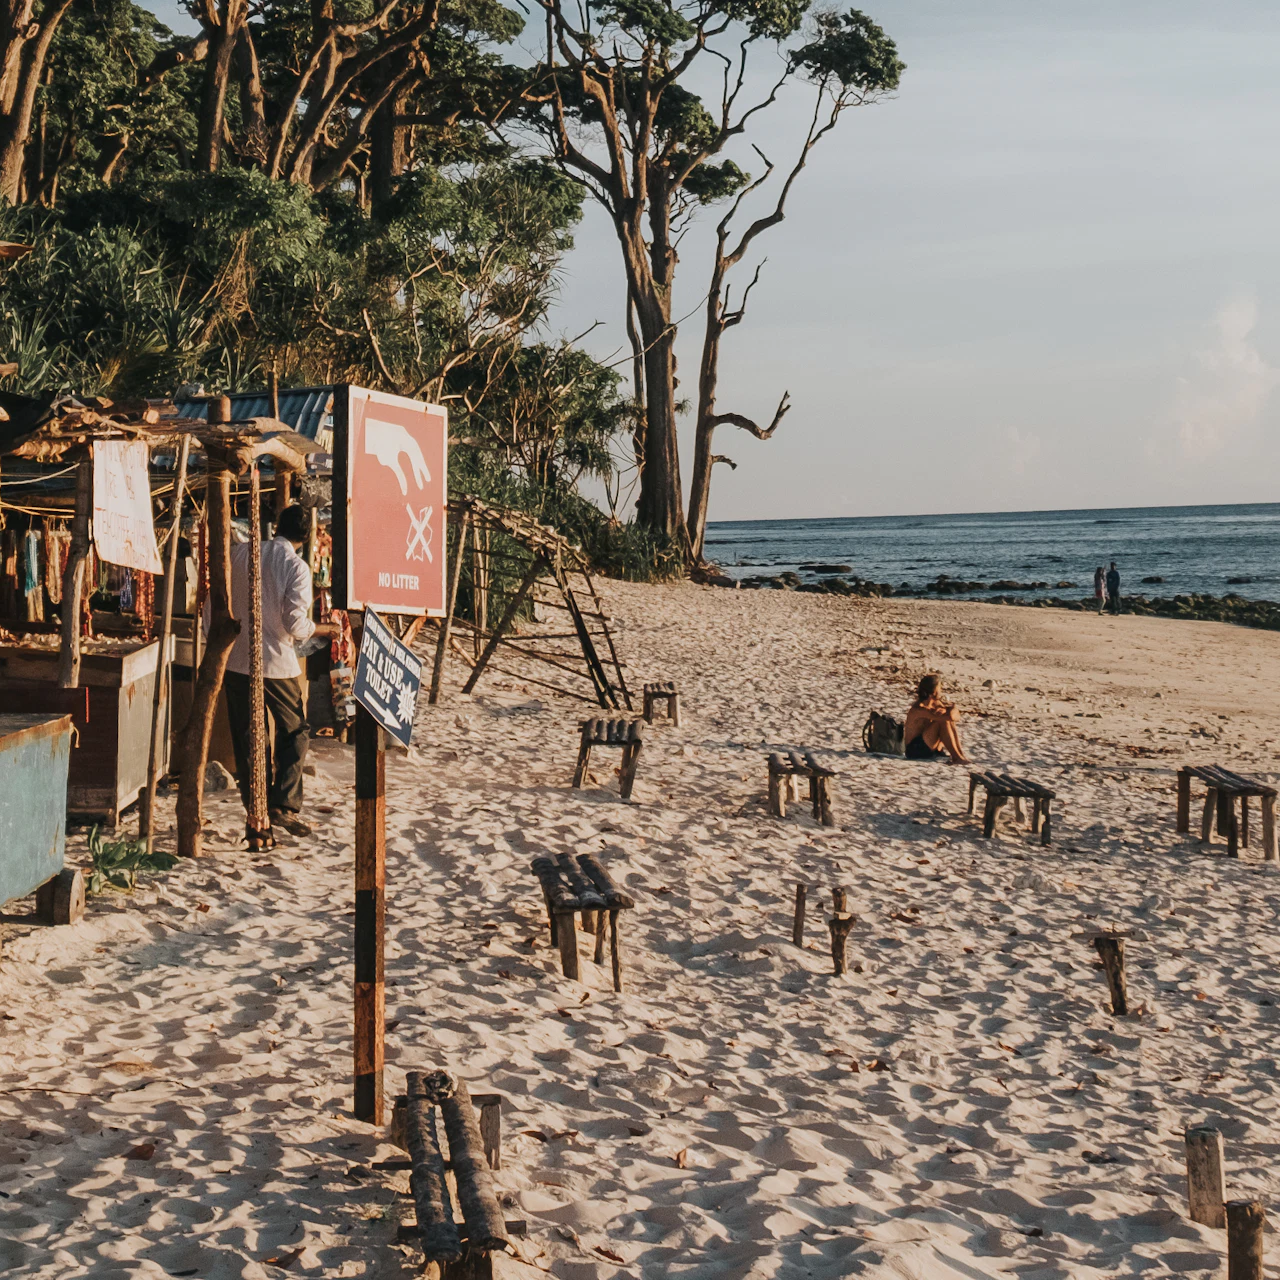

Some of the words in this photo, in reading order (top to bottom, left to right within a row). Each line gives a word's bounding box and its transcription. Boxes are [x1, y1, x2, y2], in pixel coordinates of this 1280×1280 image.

[378, 571, 391, 588] NO
[392, 573, 420, 591] LITTER
[362, 631, 380, 665] PAY
[377, 652, 385, 673] &
[383, 656, 404, 691] USE
[365, 663, 393, 704] TOILET
